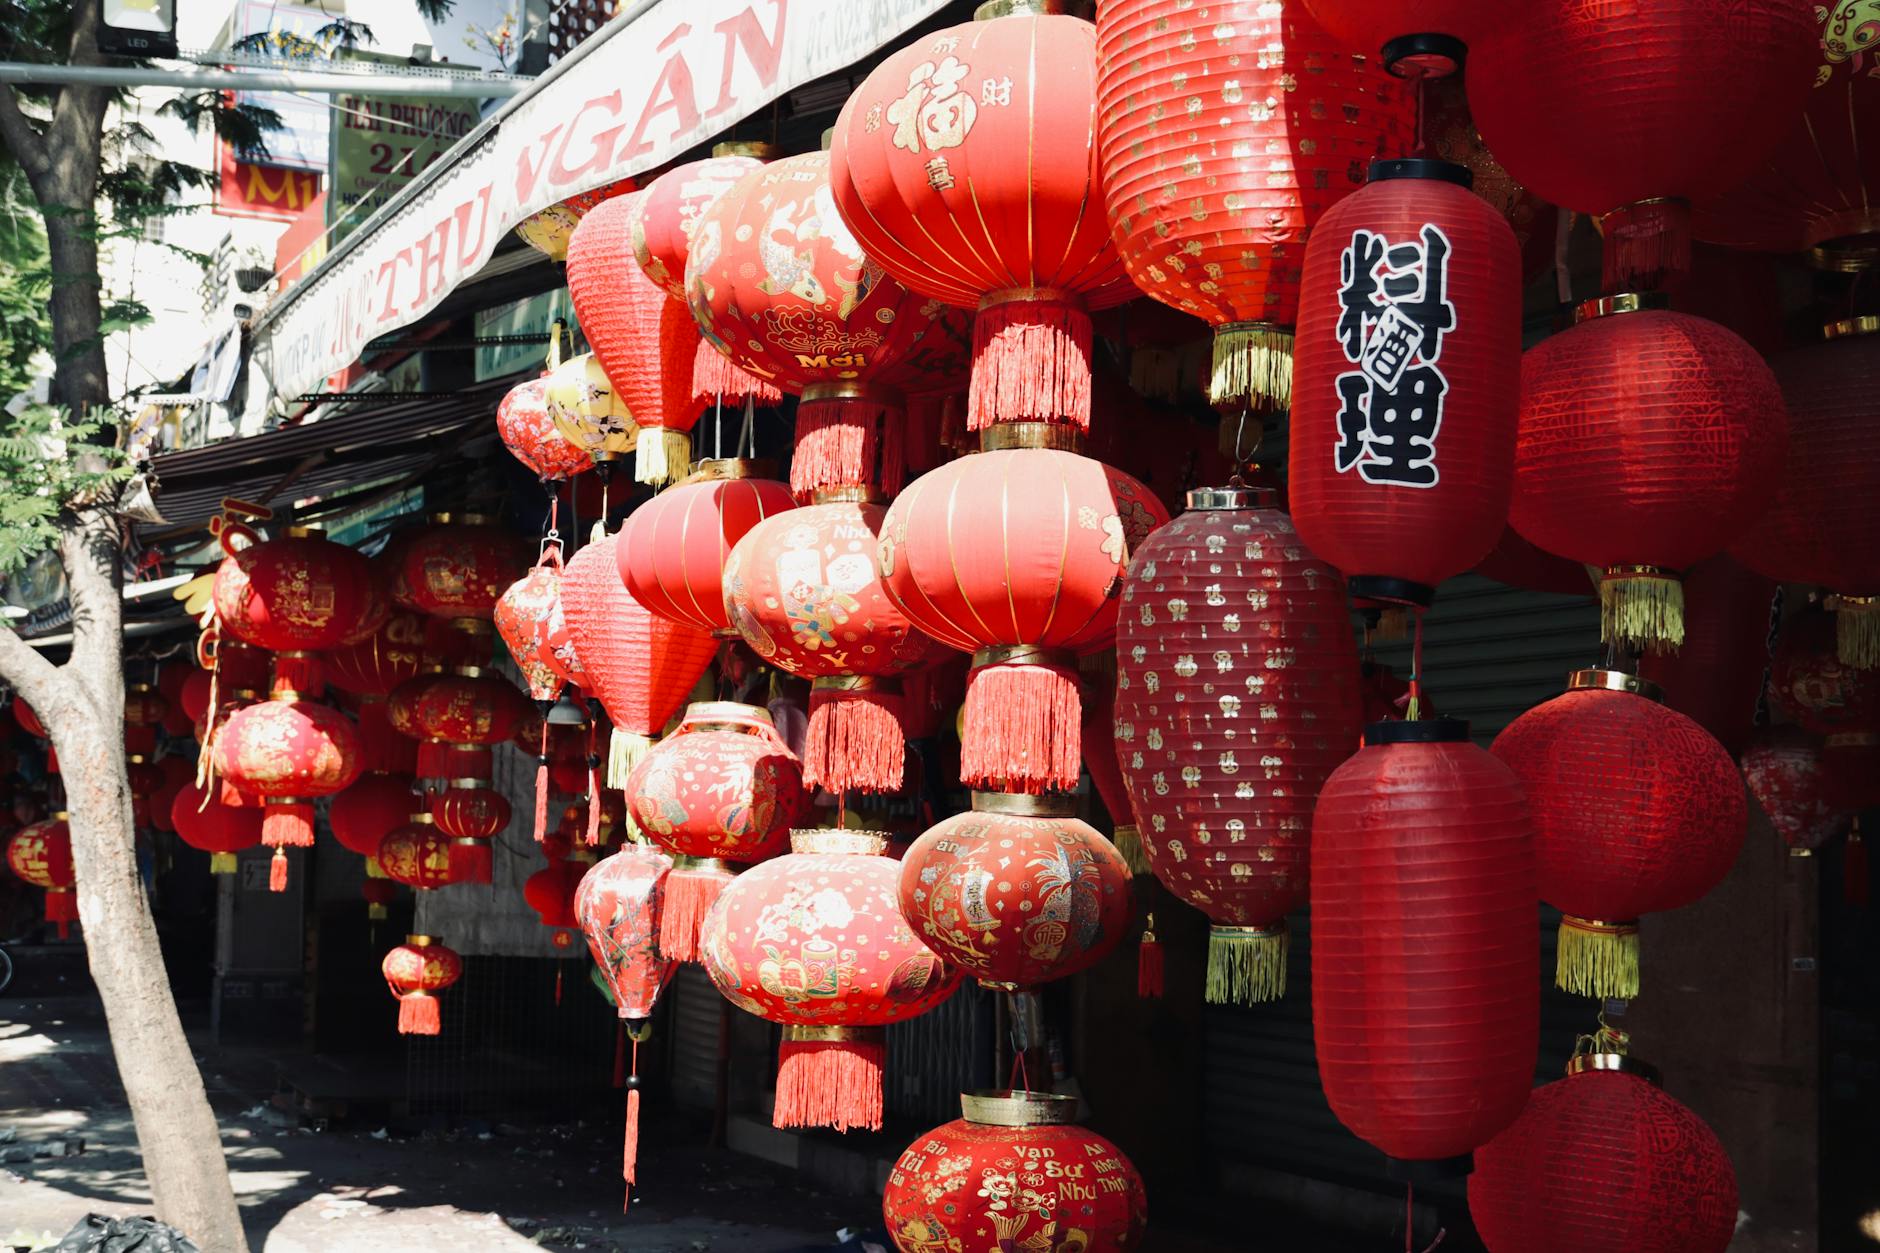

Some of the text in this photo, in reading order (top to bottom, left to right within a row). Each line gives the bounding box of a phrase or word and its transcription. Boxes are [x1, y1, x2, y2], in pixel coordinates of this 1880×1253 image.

[127, 38, 149, 48] LED
[886, 55, 978, 154] 福
[369, 143, 442, 178] 21
[376, 181, 494, 324] THU
[795, 351, 868, 368] Mới
[1013, 1145, 1055, 1161] Vạn
[1045, 1160, 1084, 1181] Sự
